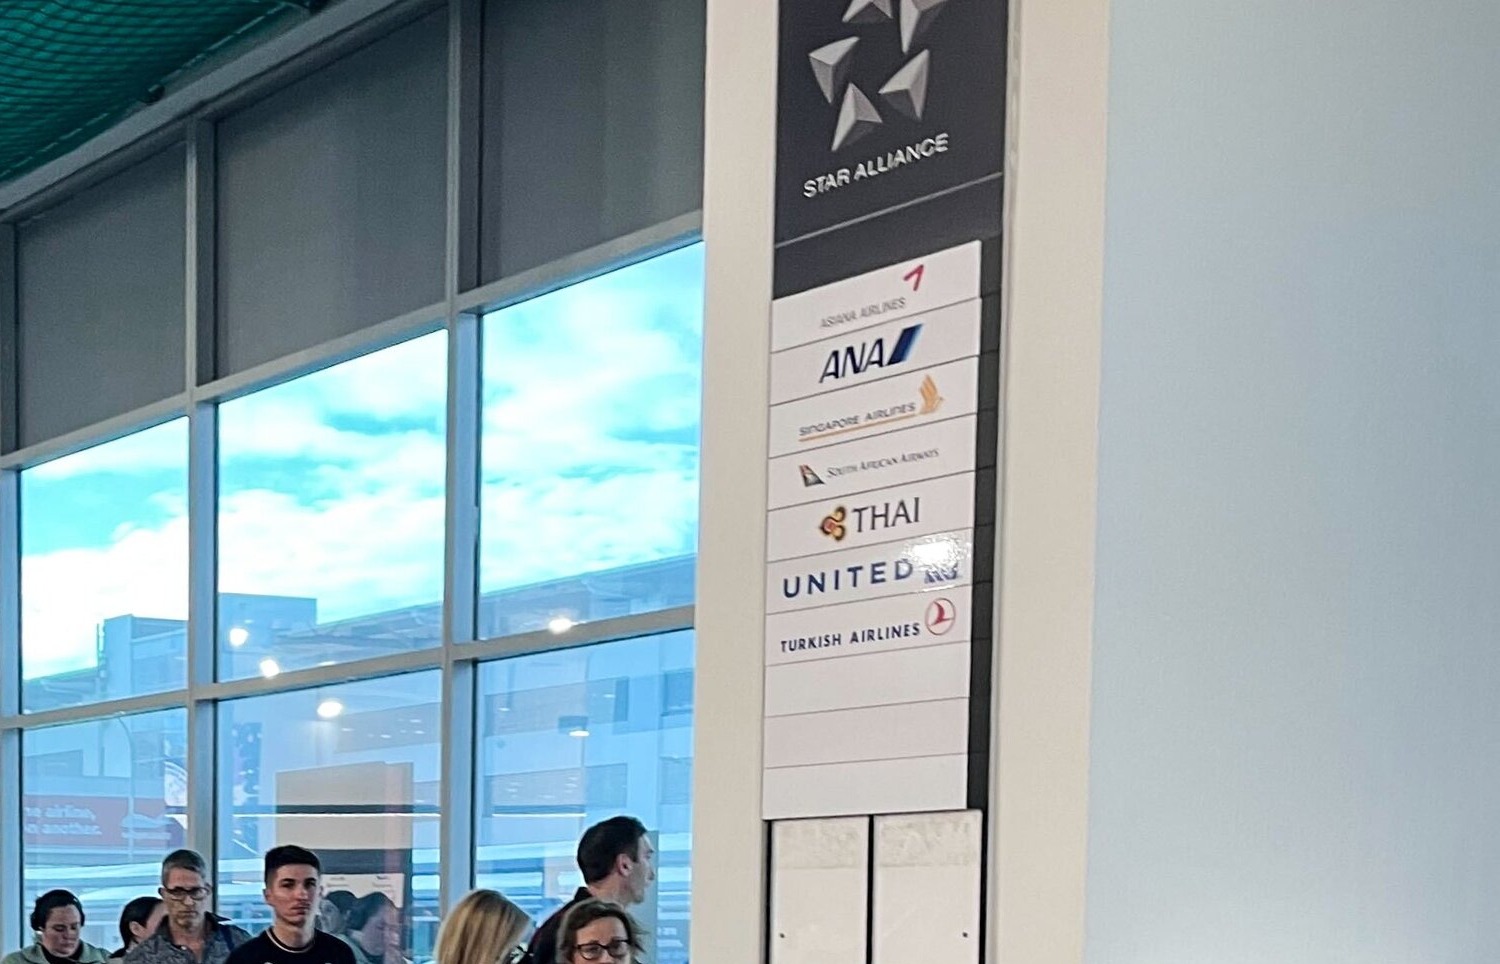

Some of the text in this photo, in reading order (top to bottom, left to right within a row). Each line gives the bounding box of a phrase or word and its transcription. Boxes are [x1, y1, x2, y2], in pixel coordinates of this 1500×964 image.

[803, 132, 949, 199] STAR ALLIANCE
[860, 296, 907, 319] AIRLINES
[818, 337, 884, 384] ANA
[799, 402, 917, 437] SINGAPORE AIRLINES
[852, 496, 920, 533] THAI
[783, 558, 914, 599] UNITED
[780, 622, 921, 653] TURKISH AIRLINES
